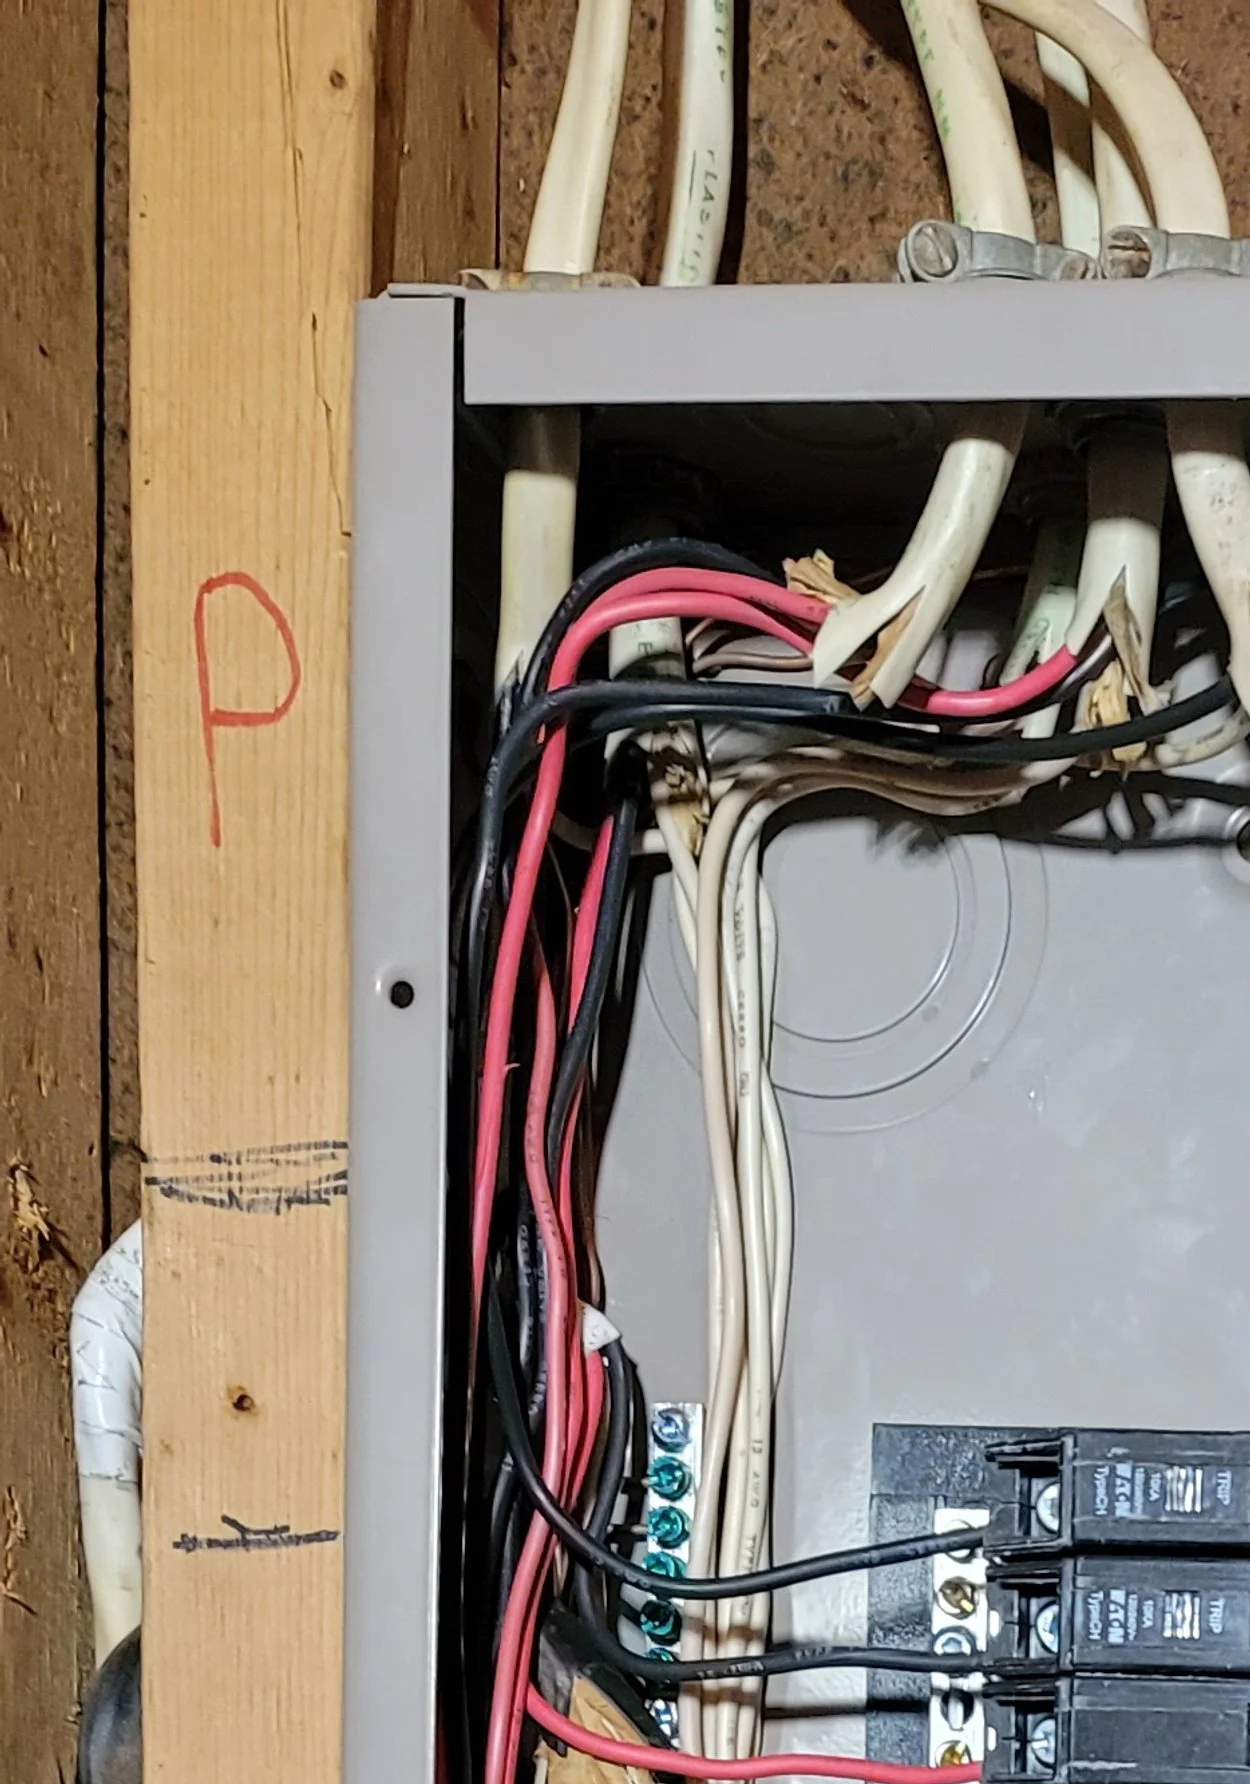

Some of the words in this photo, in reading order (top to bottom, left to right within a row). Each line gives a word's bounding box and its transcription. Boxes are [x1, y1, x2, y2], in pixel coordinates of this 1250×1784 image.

[193, 571, 302, 847] P
[1215, 1471, 1232, 1505] TRIP
[1208, 1599, 1224, 1633] TRIP
